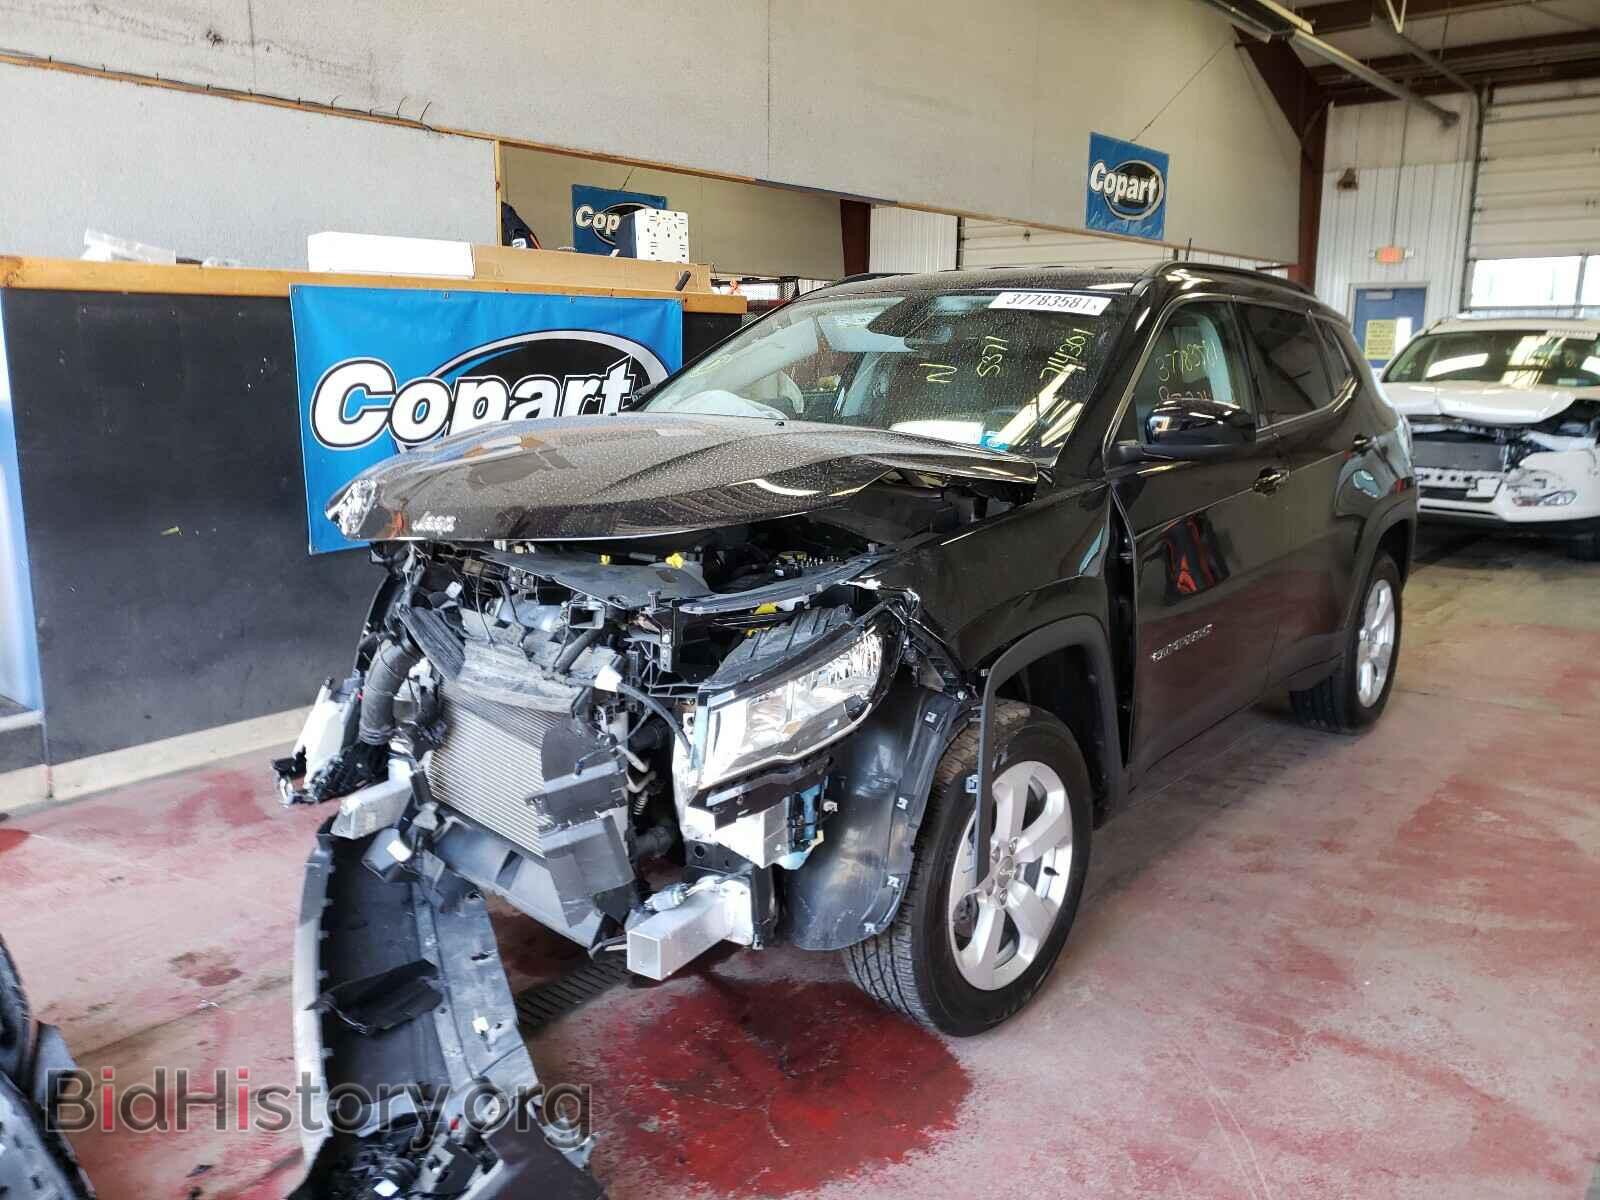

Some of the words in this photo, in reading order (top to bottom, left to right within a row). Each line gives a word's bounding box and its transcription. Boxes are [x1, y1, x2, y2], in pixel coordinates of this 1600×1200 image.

[1090, 161, 1158, 203] Copart
[575, 204, 622, 237] Cop
[1005, 293, 1091, 309] 37783581
[310, 356, 638, 451] Copart
